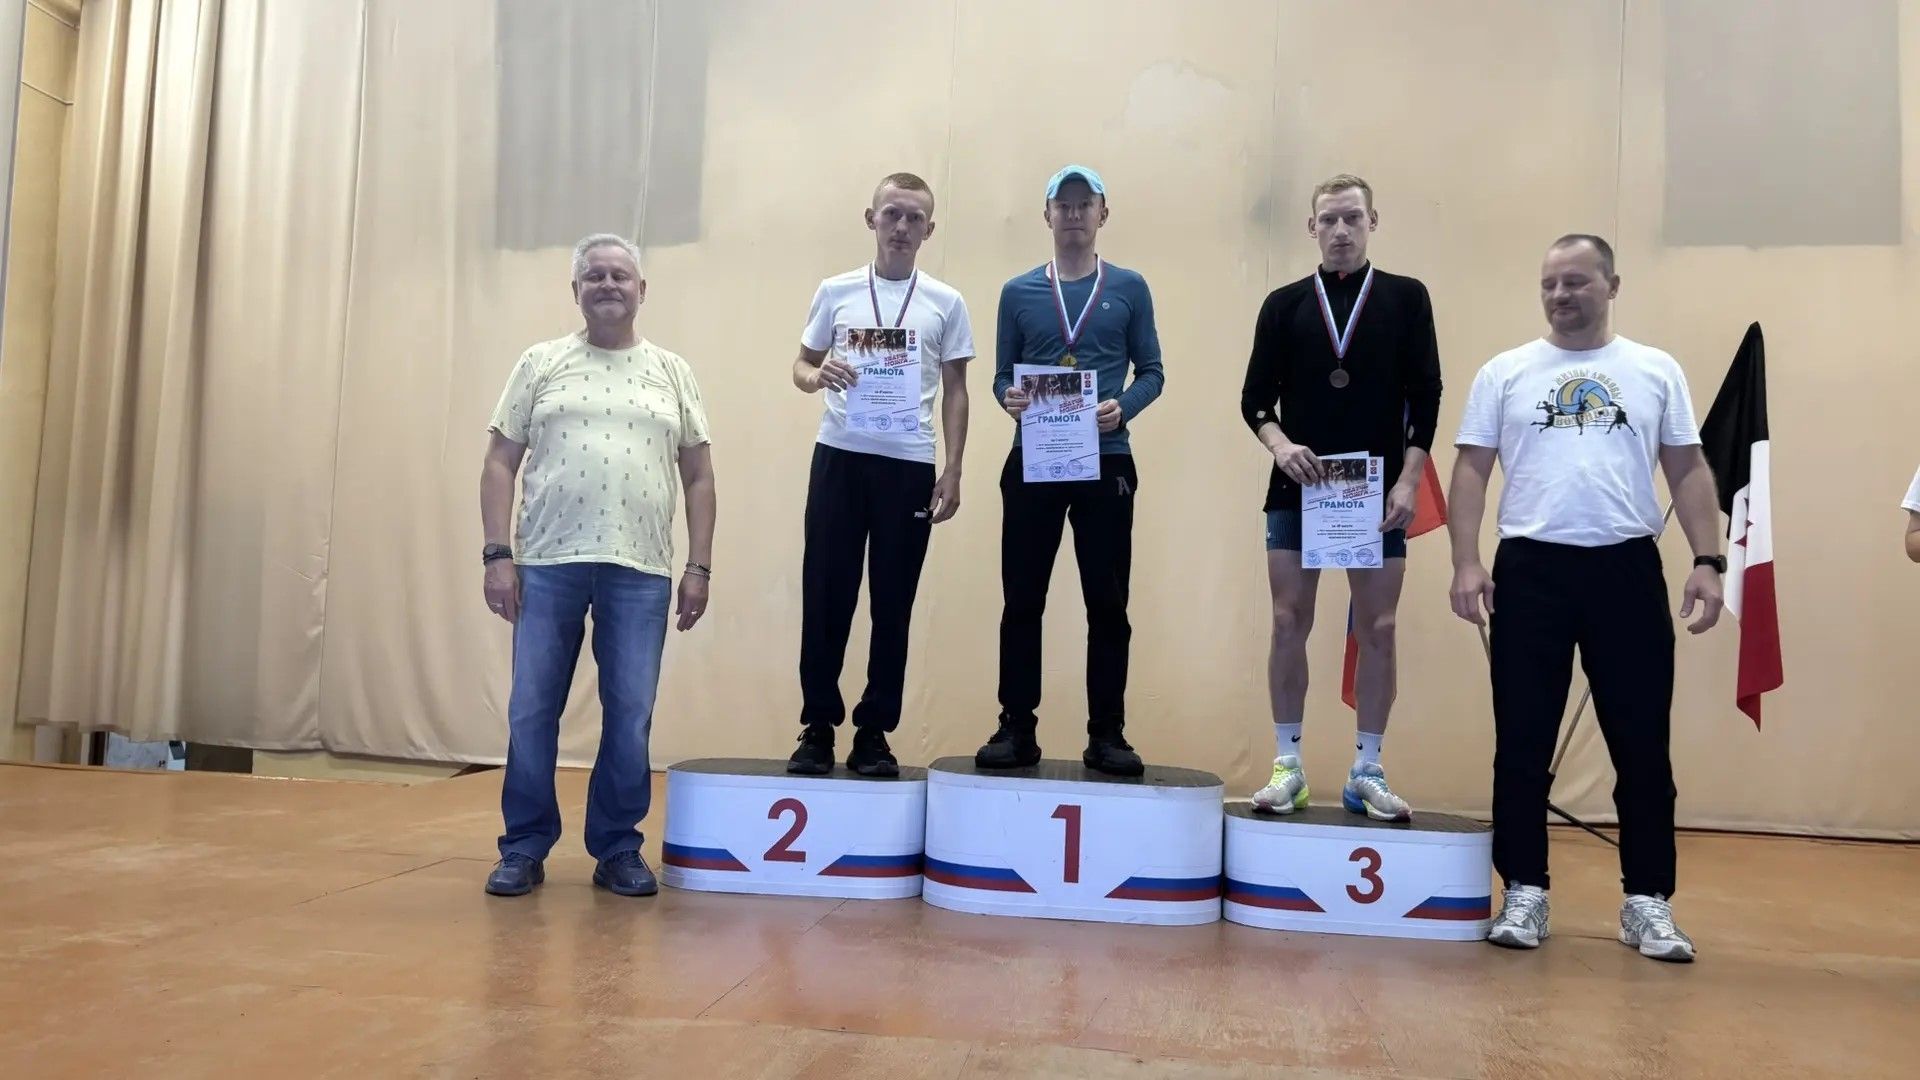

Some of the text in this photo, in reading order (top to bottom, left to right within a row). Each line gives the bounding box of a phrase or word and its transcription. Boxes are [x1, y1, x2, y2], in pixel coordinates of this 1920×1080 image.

[863, 367, 904, 376] ГРАМОТА
[1037, 414, 1080, 424] ГРАМОТА
[1319, 500, 1365, 509] ГРАМОТА
[763, 797, 807, 862] 2
[1050, 804, 1081, 884] 1
[1345, 846, 1385, 904] 3
